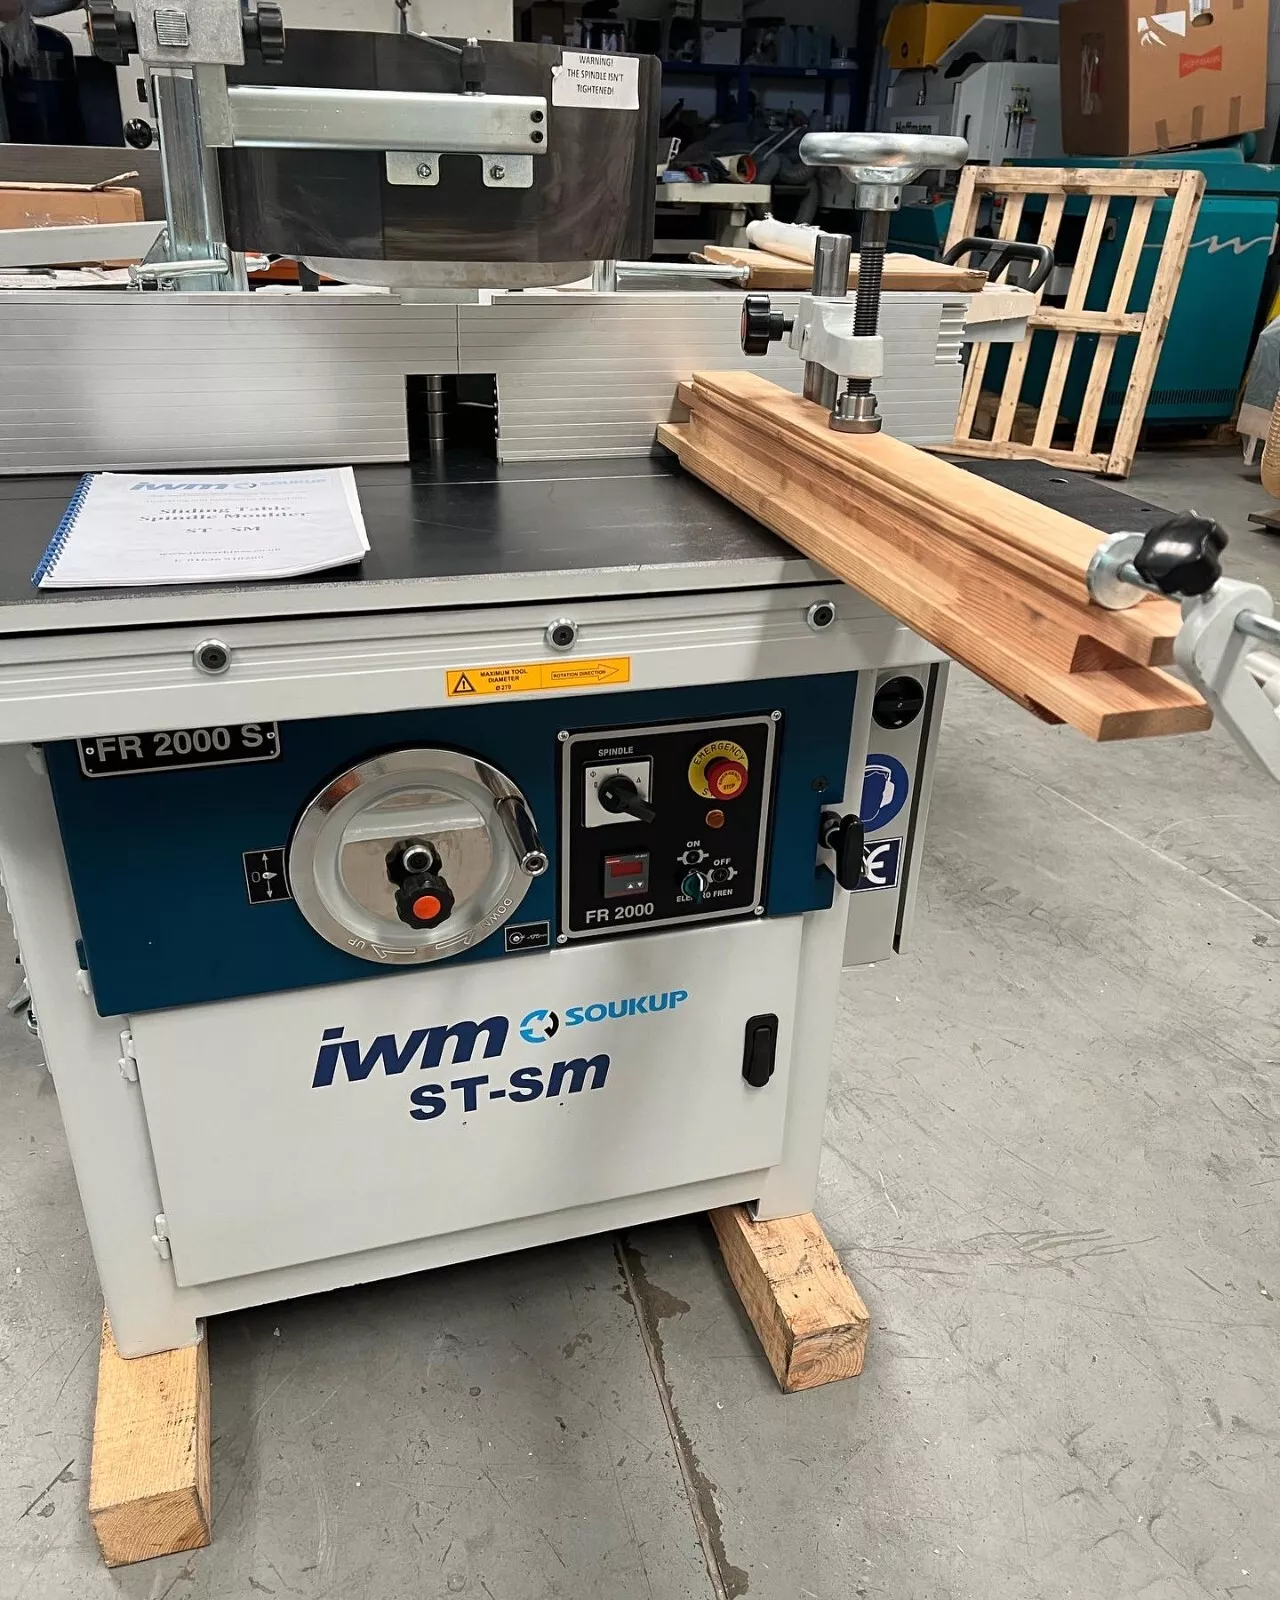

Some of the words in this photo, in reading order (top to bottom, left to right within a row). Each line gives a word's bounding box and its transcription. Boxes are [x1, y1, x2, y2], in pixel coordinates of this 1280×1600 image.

[579, 55, 614, 67] WARNING!
[567, 69, 580, 78] THE
[581, 70, 607, 81] SPINDLE
[608, 72, 624, 82] ISN'T
[577, 84, 614, 95] TIGHTENED!
[480, 669, 510, 677] MAXIMUM
[579, 670, 606, 678] DIRECTION
[488, 675, 520, 684] DIAMETER
[96, 735, 144, 762] FR
[153, 727, 231, 757] 2000
[241, 723, 264, 748] S
[598, 746, 634, 757] SPINDLE
[693, 742, 745, 765] EMERGENCY
[686, 840, 700, 848] ON
[713, 857, 731, 866] OFF
[713, 888, 733, 898] FREN
[482, 898, 513, 928] DOWN
[585, 908, 609, 924] FR
[614, 902, 654, 920] 2000
[348, 938, 366, 950] UP
[312, 1016, 509, 1088] iwm
[565, 989, 689, 1027] SOUKUP
